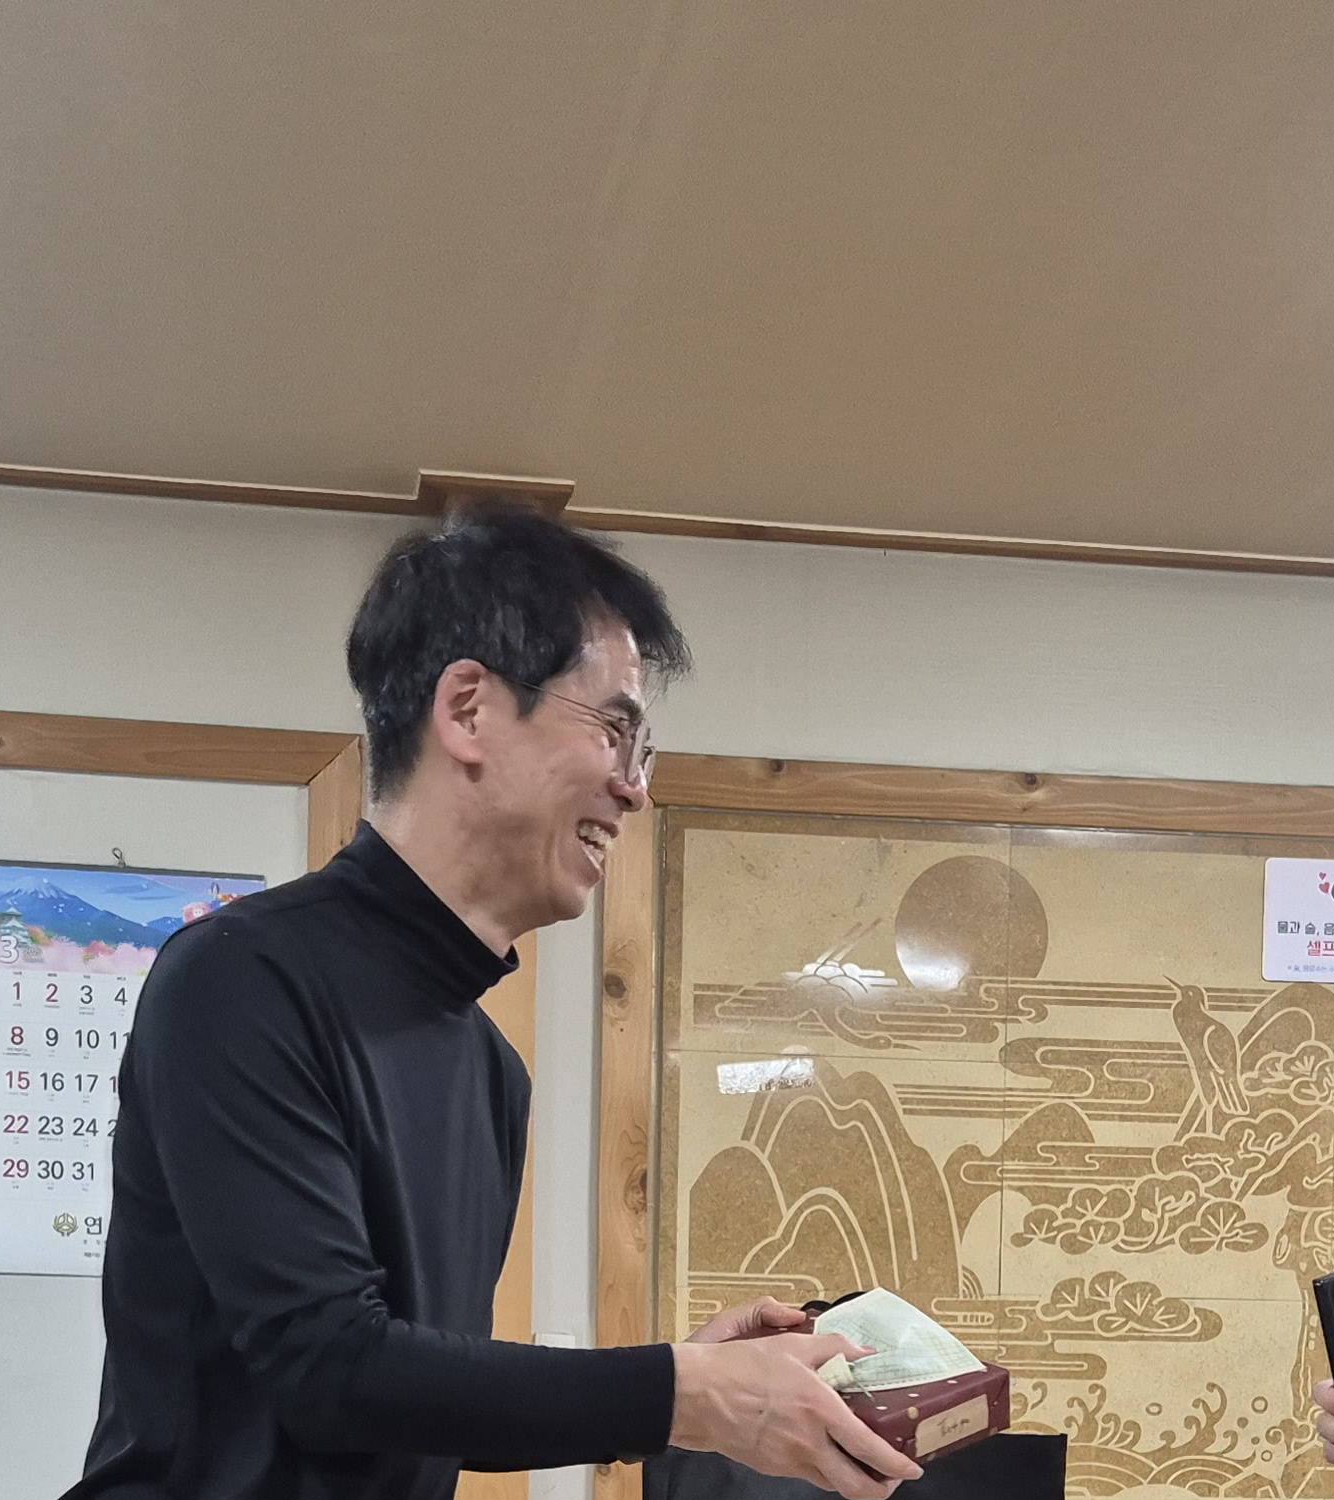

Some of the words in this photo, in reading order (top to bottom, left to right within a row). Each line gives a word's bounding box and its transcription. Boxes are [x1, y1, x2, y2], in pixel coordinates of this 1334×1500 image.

[1277, 921, 1300, 935] 물과
[0, 934, 19, 964] 3
[12, 981, 21, 1001] 1
[45, 983, 58, 1002] 2
[80, 985, 93, 1005] 3
[114, 987, 128, 1006] 4
[10, 1026, 24, 1045] 8
[45, 1027, 59, 1047] 9
[75, 1029, 100, 1049] 10
[5, 1070, 31, 1090] 15
[40, 1072, 65, 1092] 16
[74, 1073, 99, 1092] 17
[3, 1114, 29, 1134] 22
[38, 1115, 64, 1135] 23
[72, 1117, 99, 1137] 24
[3, 1158, 29, 1178] 29
[37, 1160, 64, 1180] 30
[72, 1161, 95, 1181] 31
